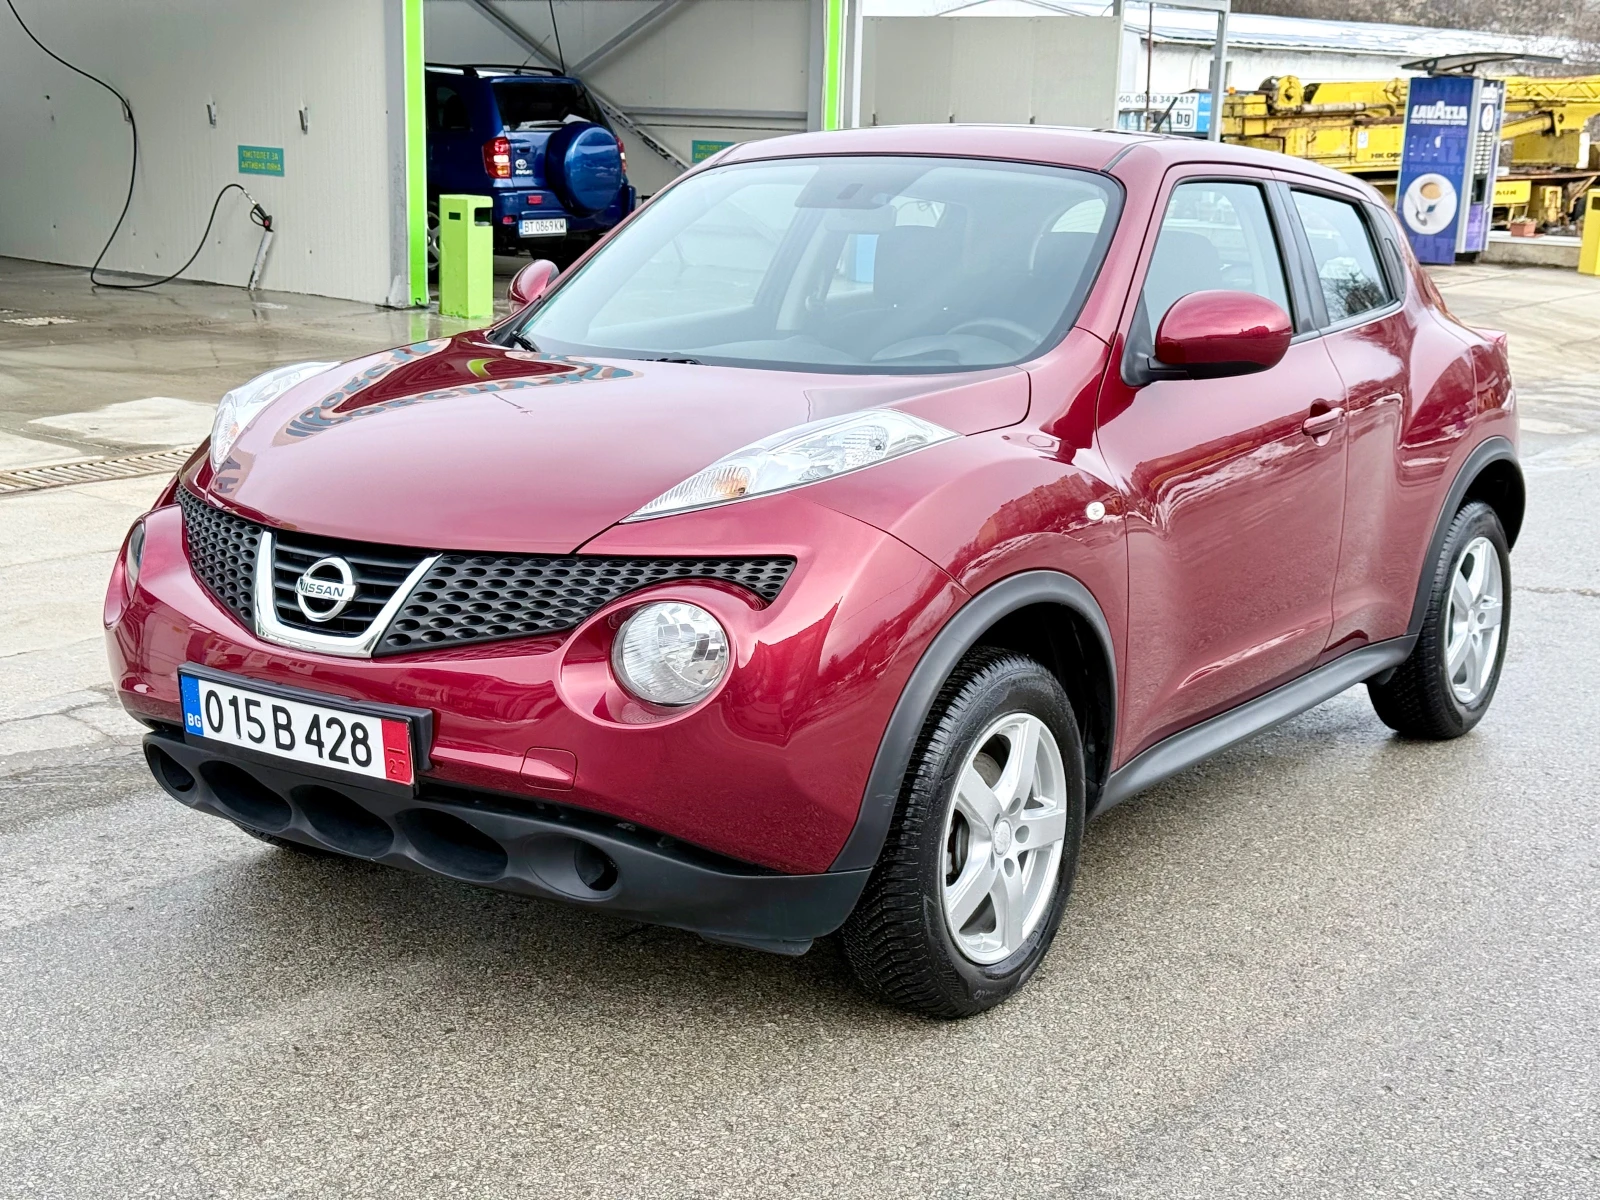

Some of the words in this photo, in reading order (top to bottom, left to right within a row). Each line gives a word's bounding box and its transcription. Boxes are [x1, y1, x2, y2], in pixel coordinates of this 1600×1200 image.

[1179, 96, 1196, 104] 417
[299, 578, 345, 598] NISSAN
[187, 712, 202, 728] BG
